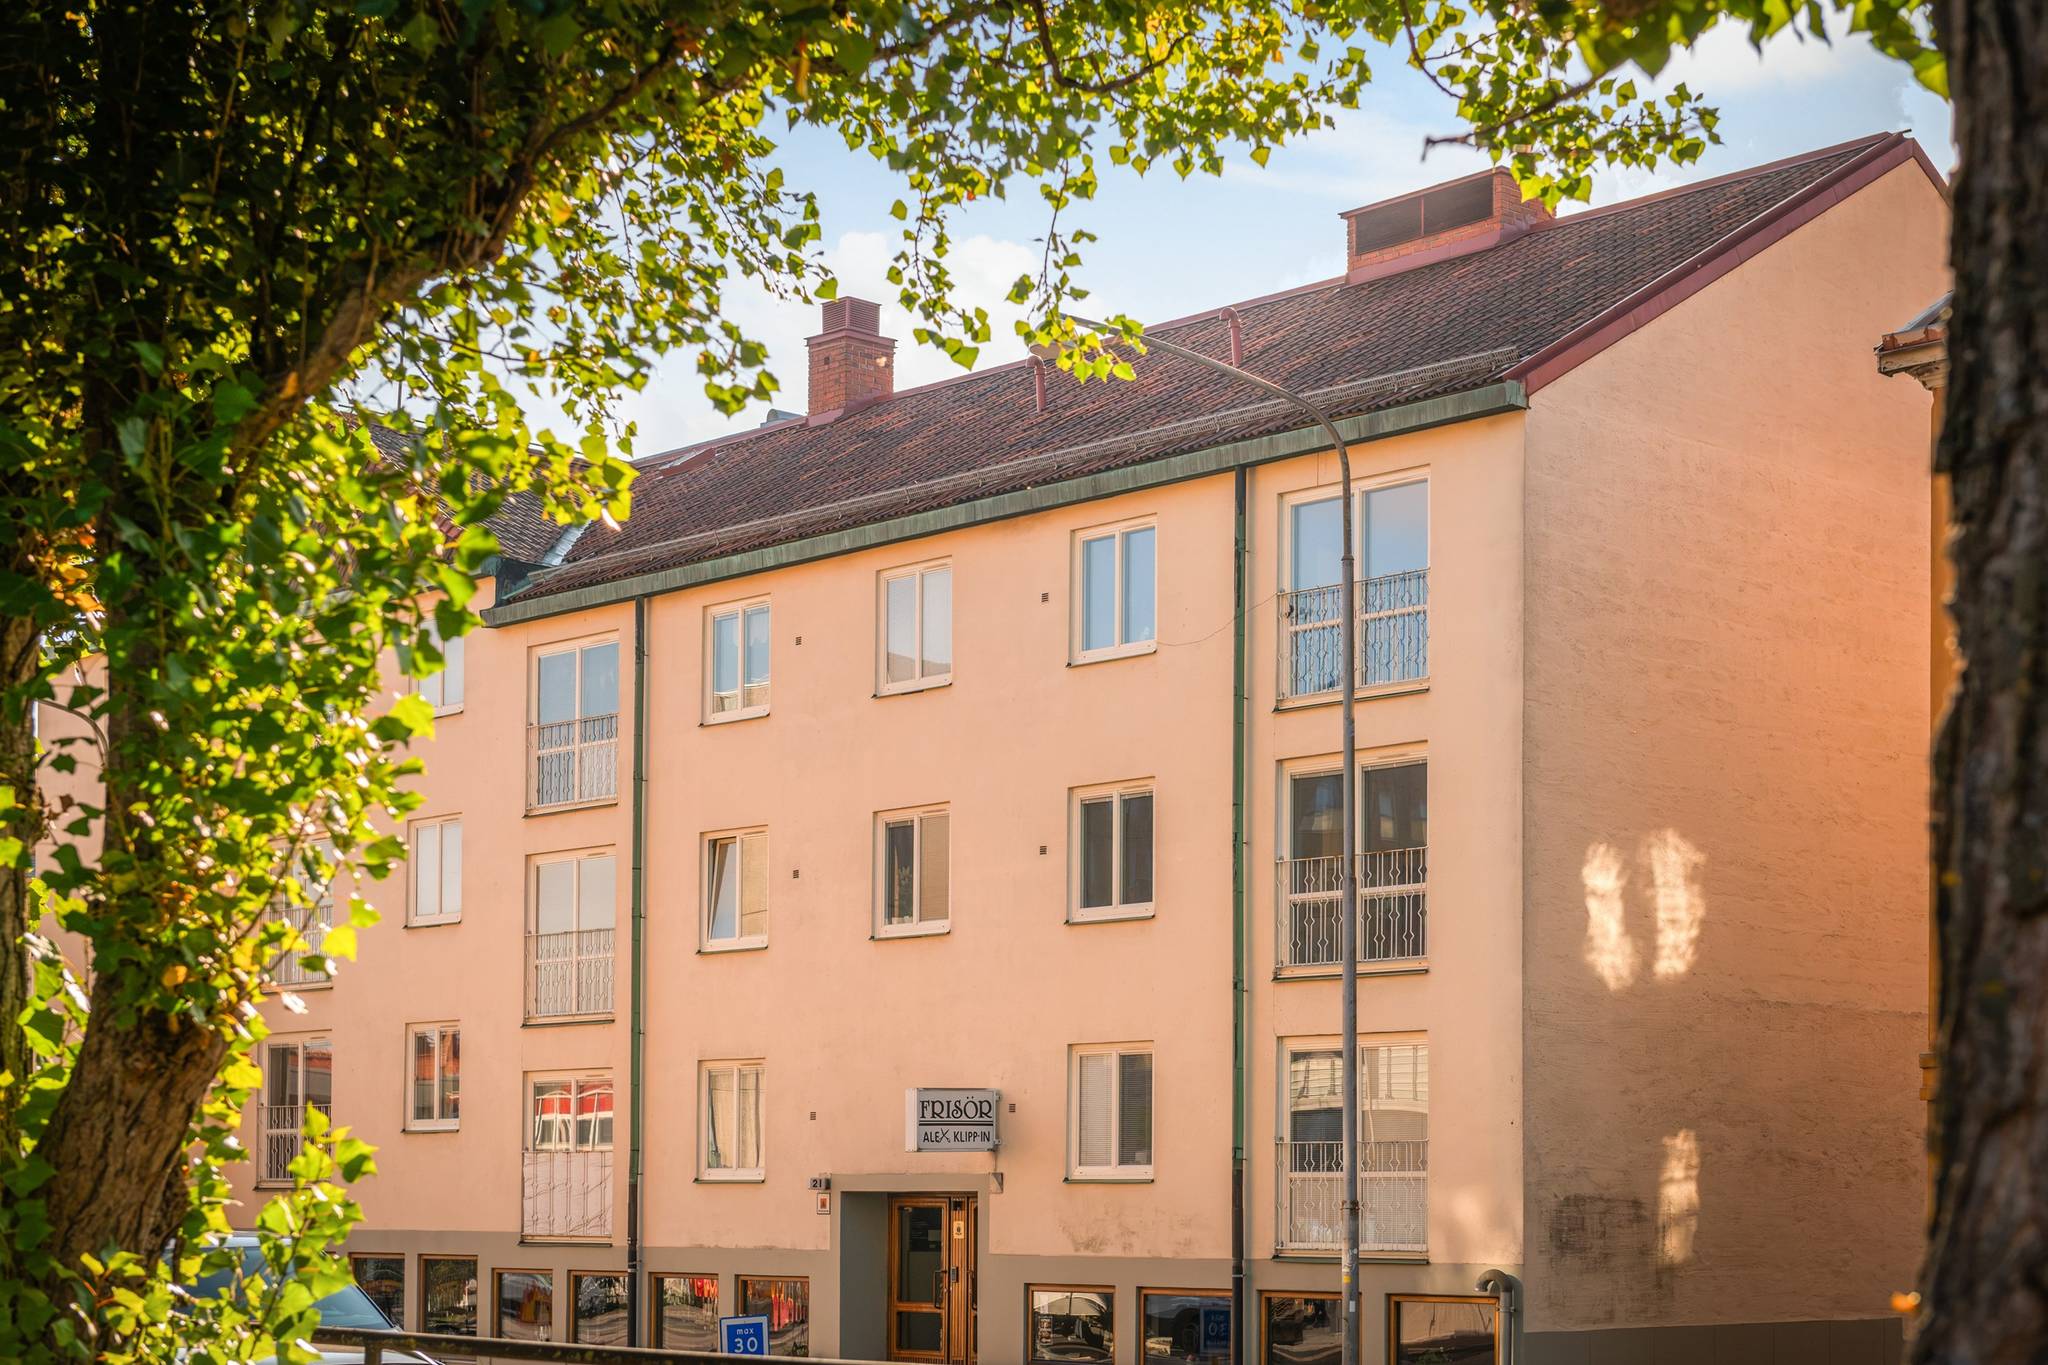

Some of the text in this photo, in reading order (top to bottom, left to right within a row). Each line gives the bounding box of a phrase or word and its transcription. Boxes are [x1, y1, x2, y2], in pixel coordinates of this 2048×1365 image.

[919, 1096, 992, 1119] FRISÖR
[923, 1128, 951, 1143] ALEX
[812, 1179, 822, 1188] 21
[734, 1337, 758, 1352] 30
